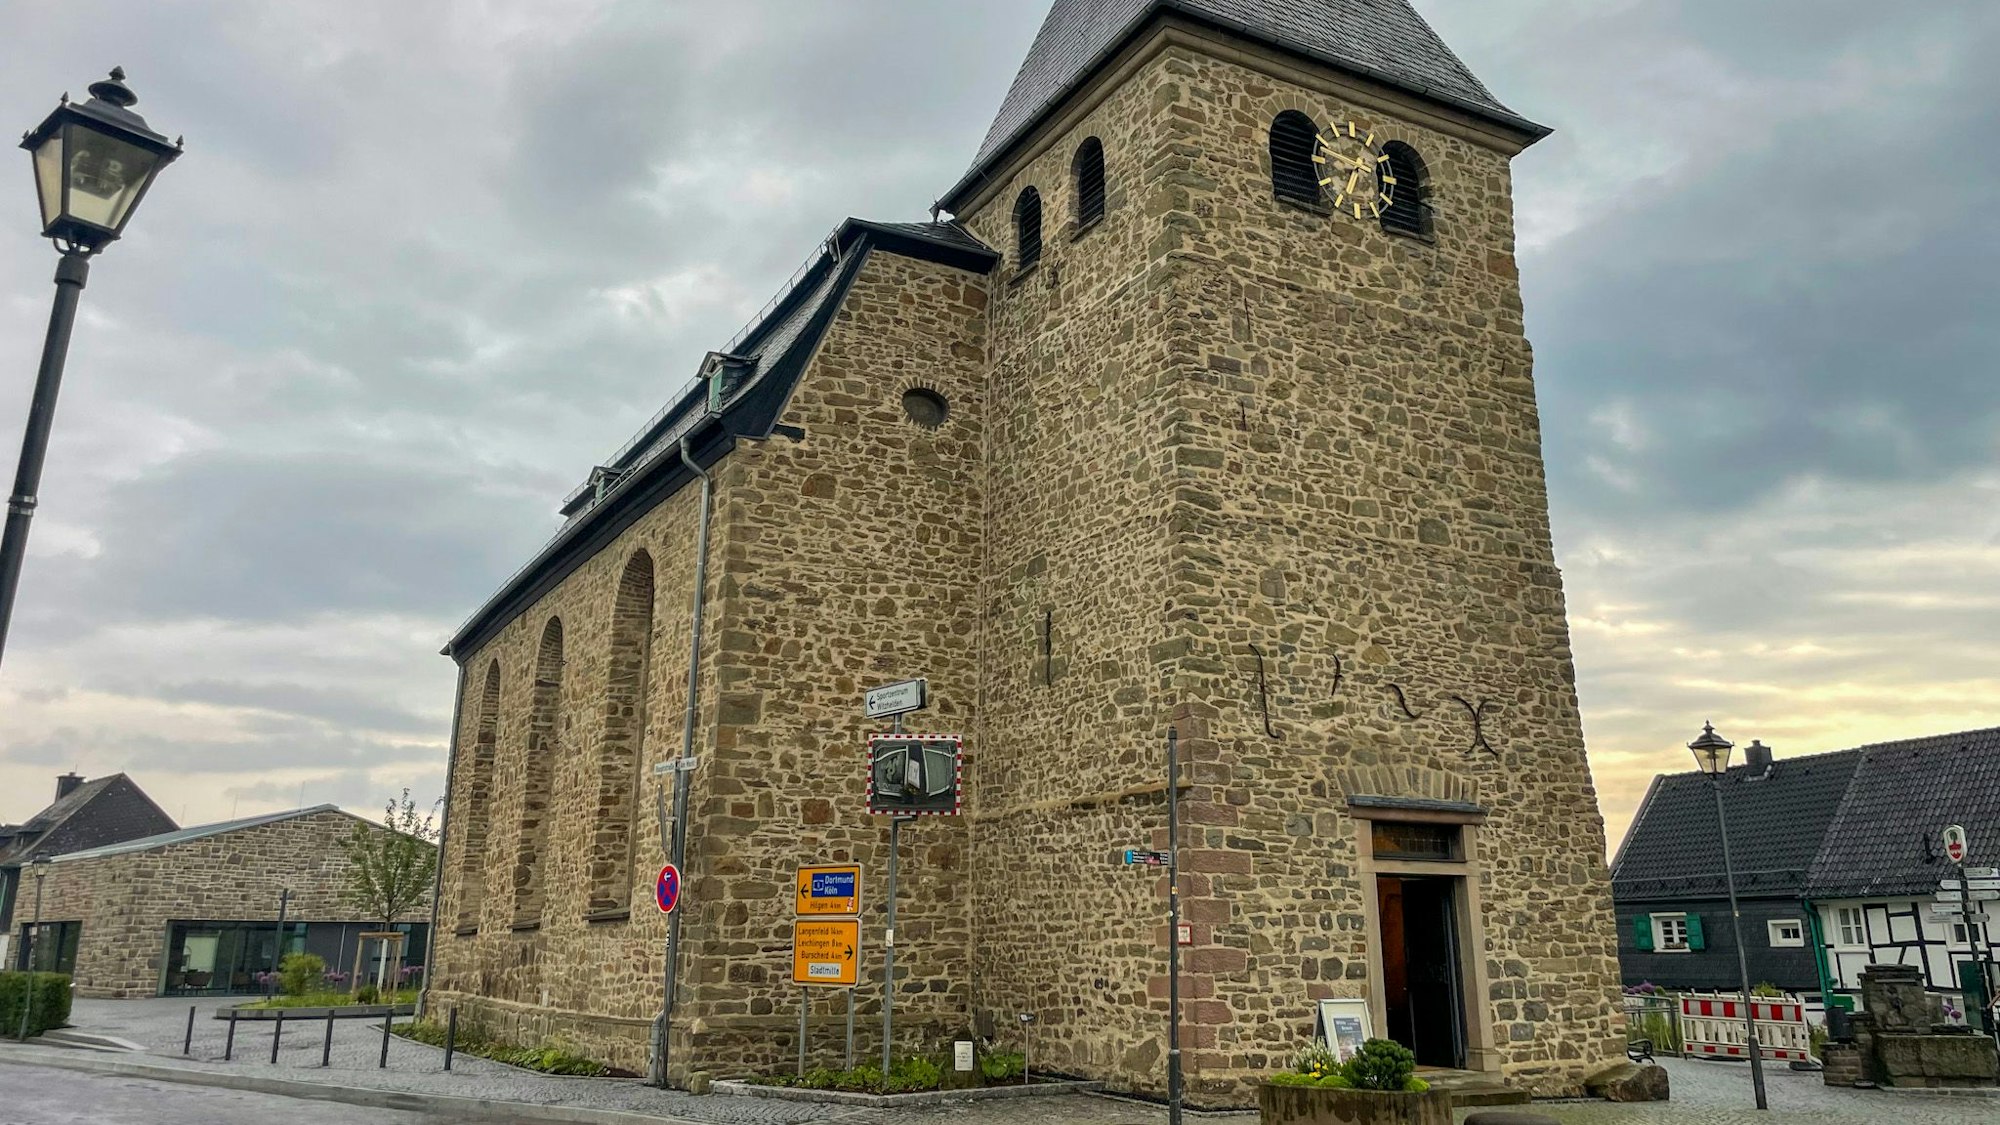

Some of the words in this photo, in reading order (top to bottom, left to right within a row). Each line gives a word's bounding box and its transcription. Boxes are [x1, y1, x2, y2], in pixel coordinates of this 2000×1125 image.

[877, 688, 908, 701] Sportzentrum
[825, 875, 854, 884] Dortmund
[824, 886, 838, 895] Köln
[810, 901, 828, 911] Hilgen
[798, 927, 829, 937] Langenfeld
[798, 938, 830, 949] Leichlingen
[801, 950, 829, 959] Burscheid
[810, 965, 839, 975] Stadtmitte
